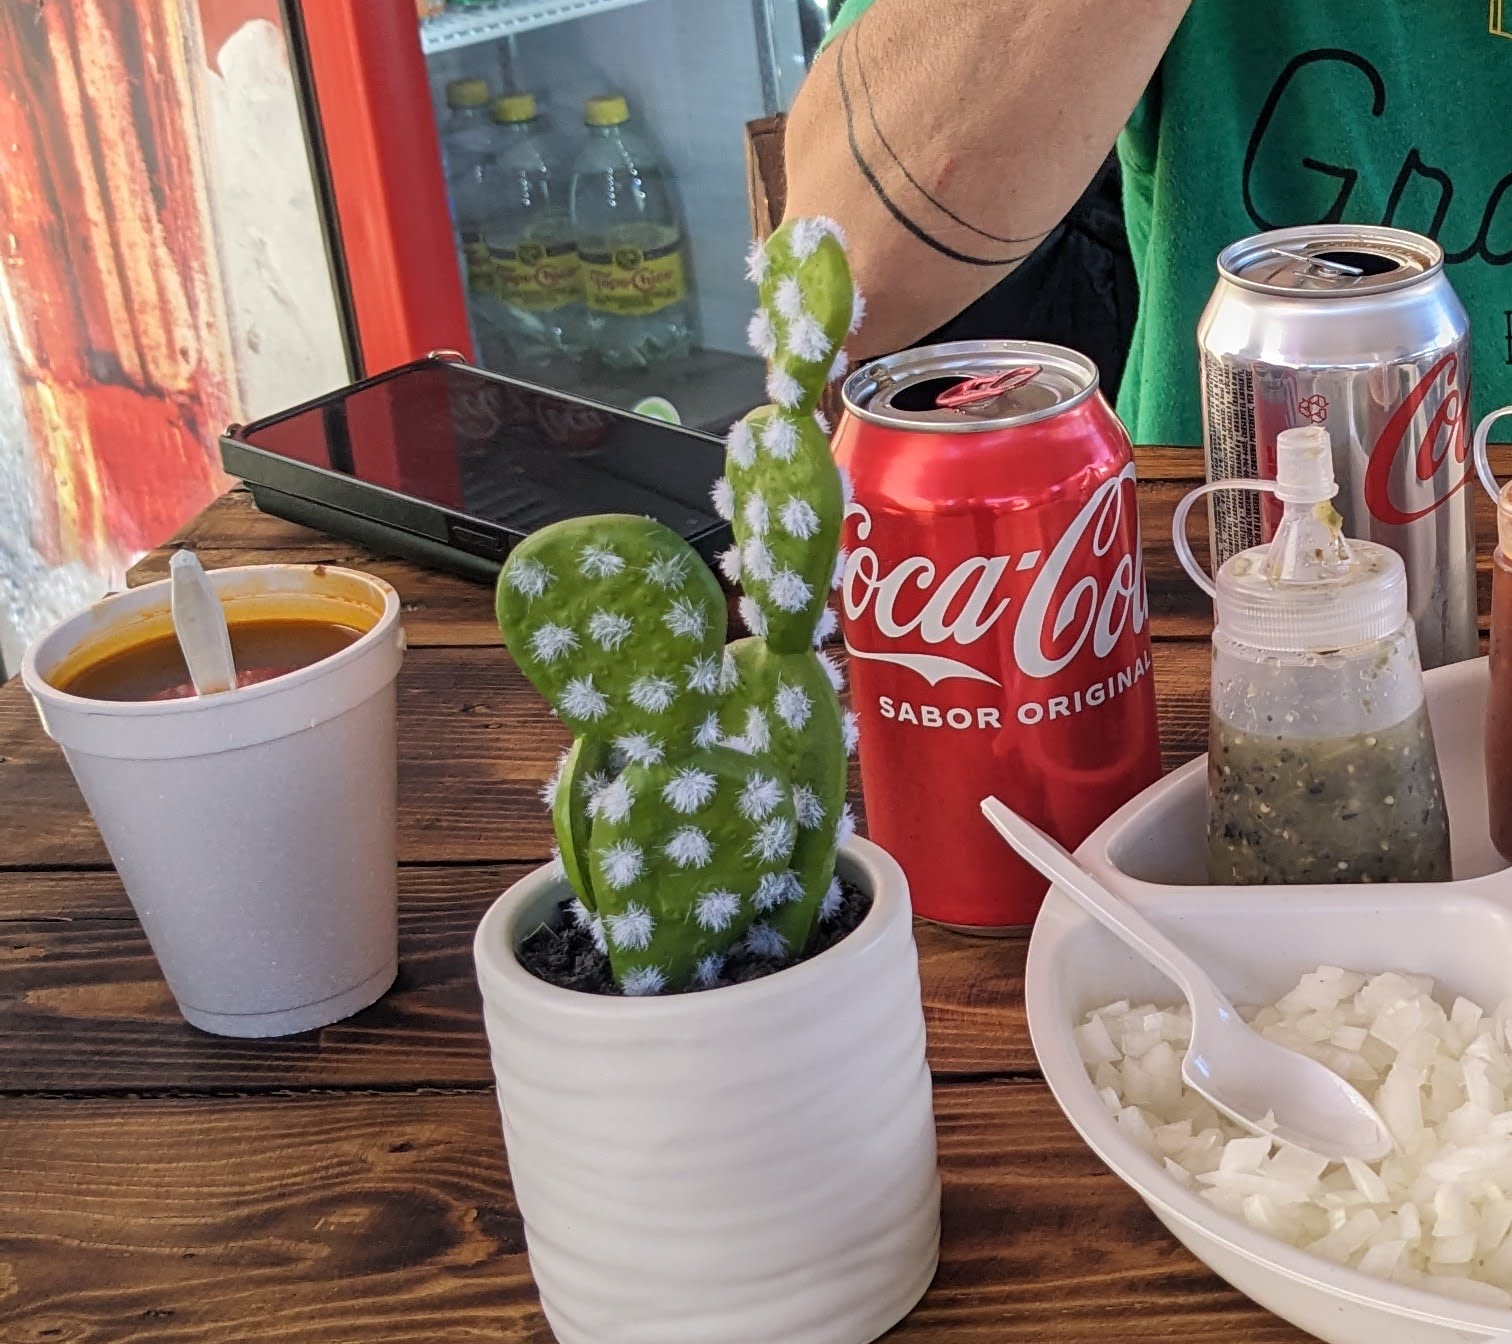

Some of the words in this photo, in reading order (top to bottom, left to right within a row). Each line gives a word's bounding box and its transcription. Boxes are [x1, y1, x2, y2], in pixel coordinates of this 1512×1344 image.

[842, 461, 1149, 680] oca-Col
[879, 695, 1002, 730] SABOR
[1017, 650, 1152, 725] ORIGINAL
